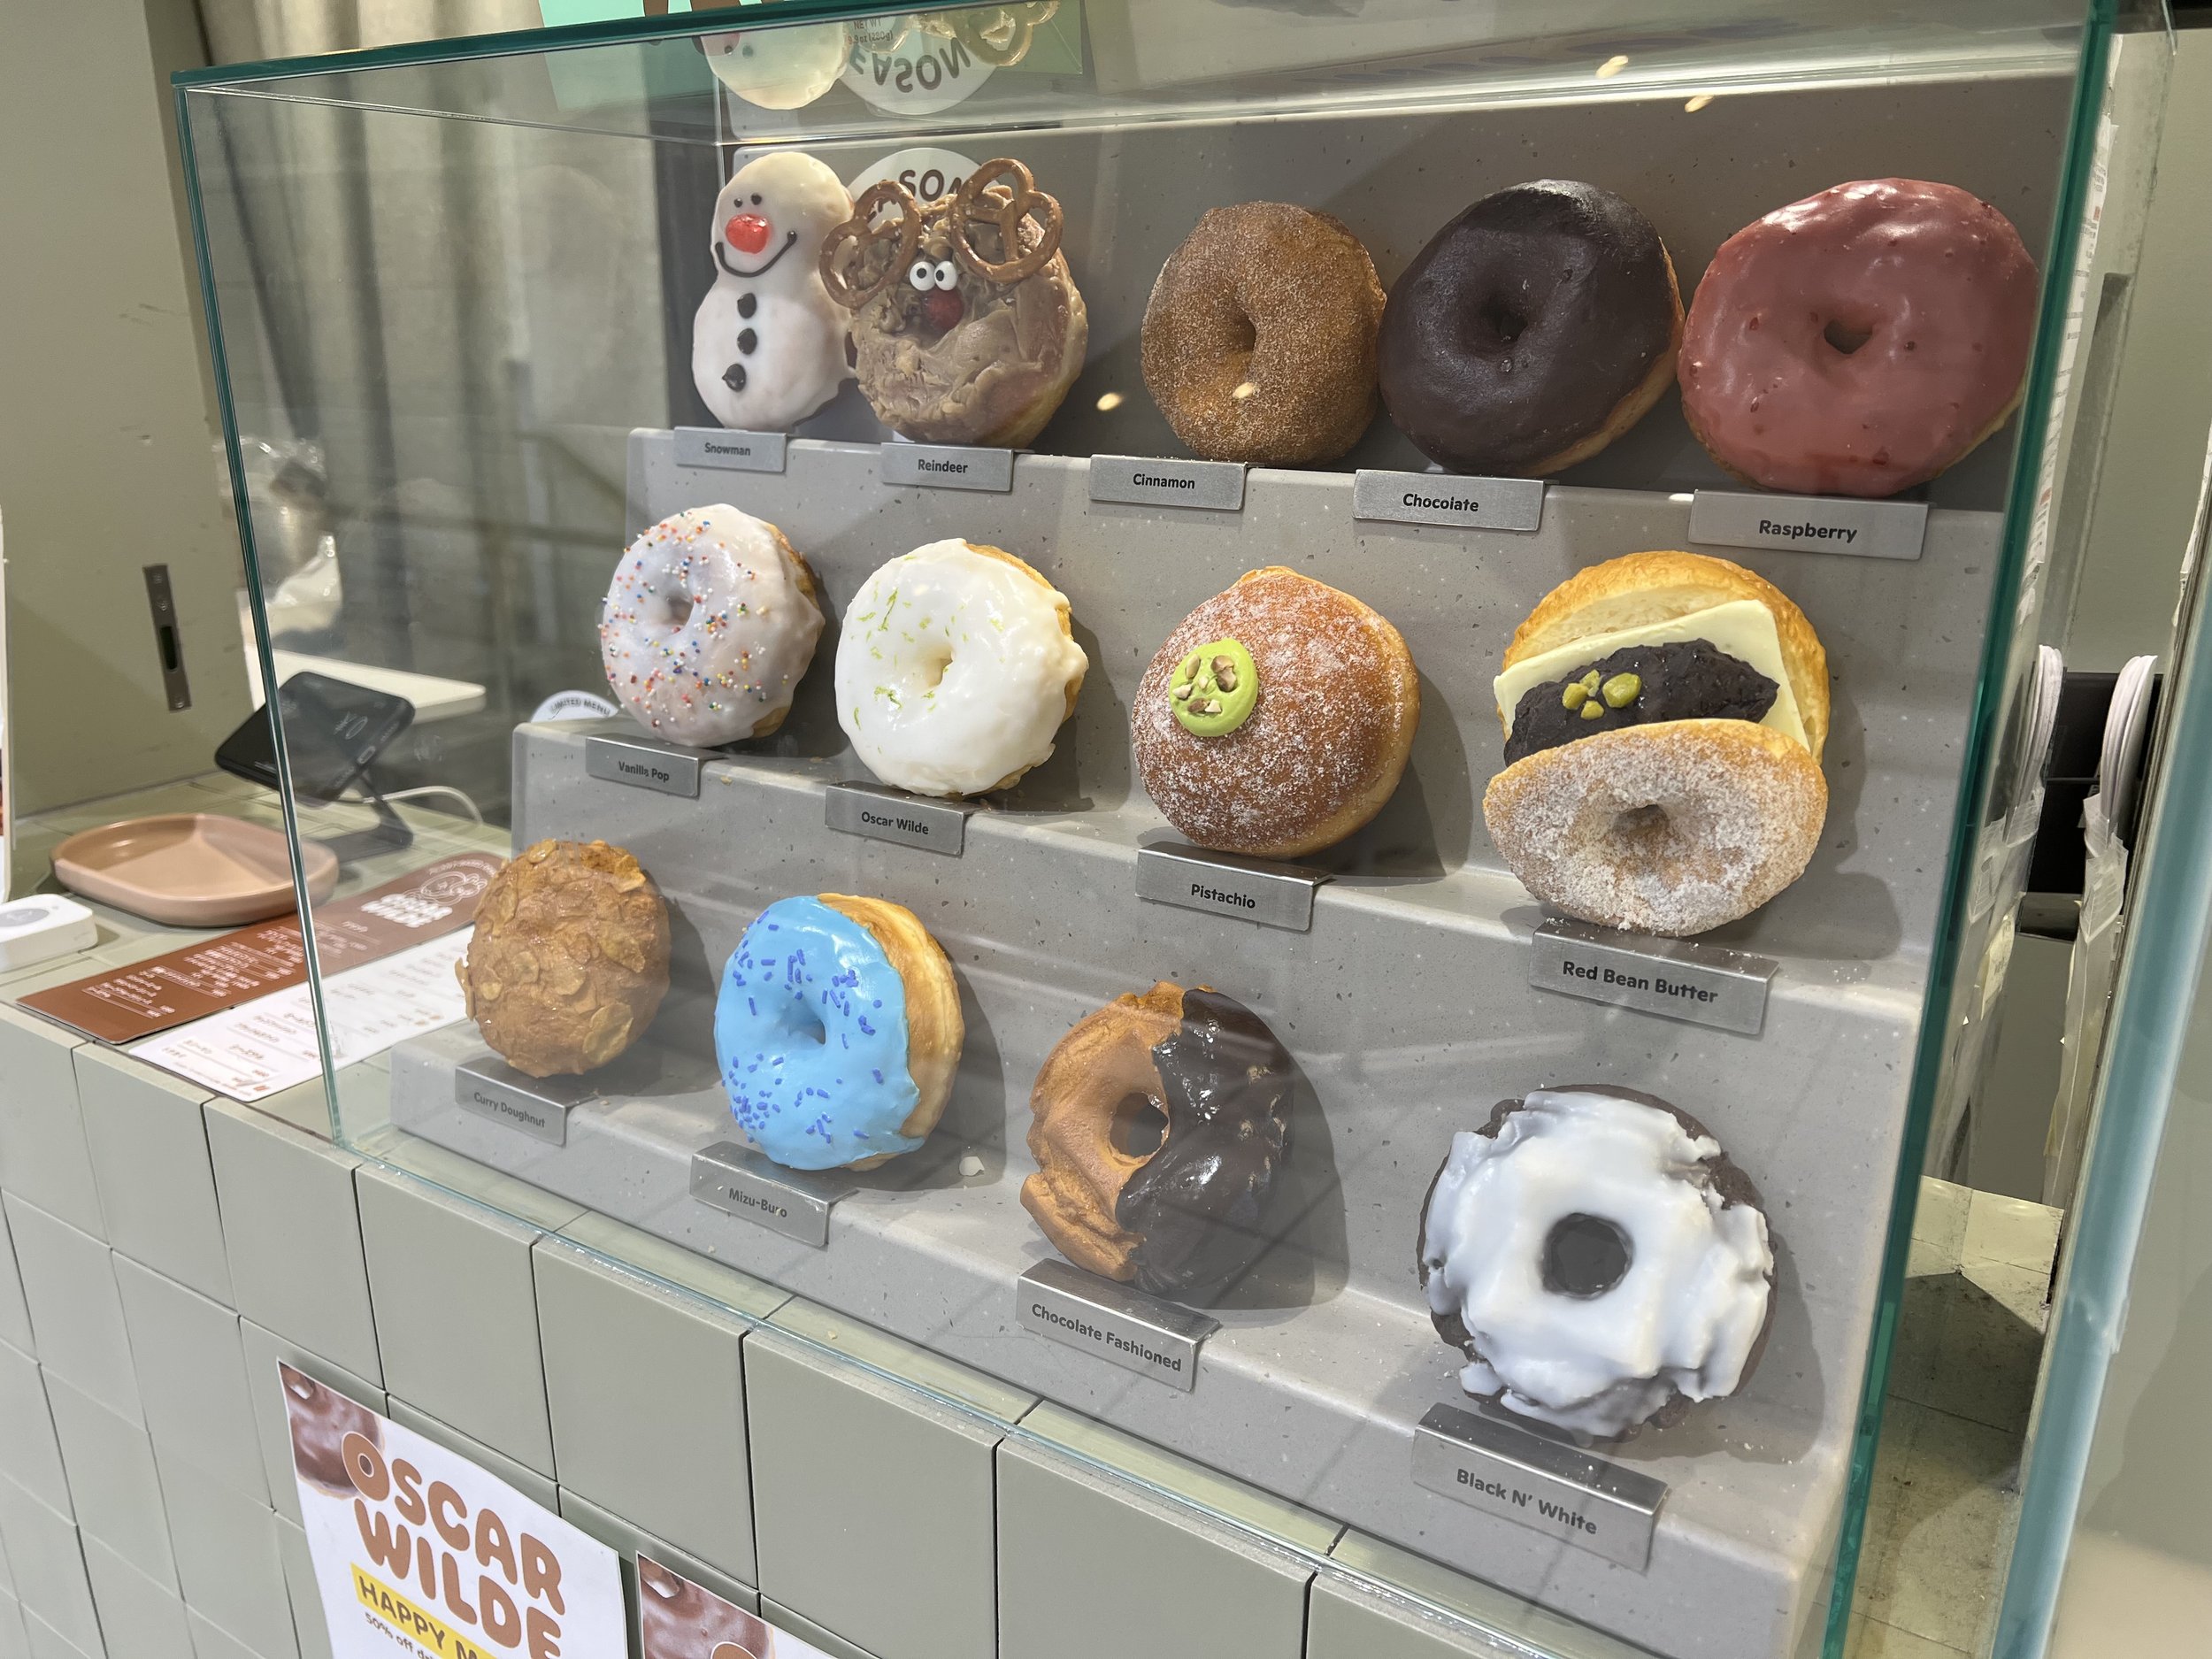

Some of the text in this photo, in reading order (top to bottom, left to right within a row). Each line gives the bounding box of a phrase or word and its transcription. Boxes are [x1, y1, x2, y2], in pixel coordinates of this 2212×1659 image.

[704, 442, 751, 457] Snowman
[918, 458, 968, 474] Reindeer
[1133, 472, 1195, 489] Cinnamon
[1402, 493, 1479, 512] Chocolate
[1758, 519, 1858, 543] Raspberry
[618, 760, 670, 784] Vanilla Pop
[862, 811, 929, 834] Oscar Wilde
[1190, 884, 1256, 910] Pistachio
[1563, 961, 1718, 1003] Red Bean Butter
[474, 1092, 545, 1128] Curry Doughnut
[1032, 1303, 1182, 1372] Chocolate Fashioned
[1456, 1469, 1507, 1500] Black
[1538, 1500, 1597, 1535] White
[342, 1432, 565, 1616] OSCAR
[354, 1498, 561, 1659] WILDE
[359, 1575, 445, 1650] HAPPY
[365, 1611, 413, 1653] 50% off
